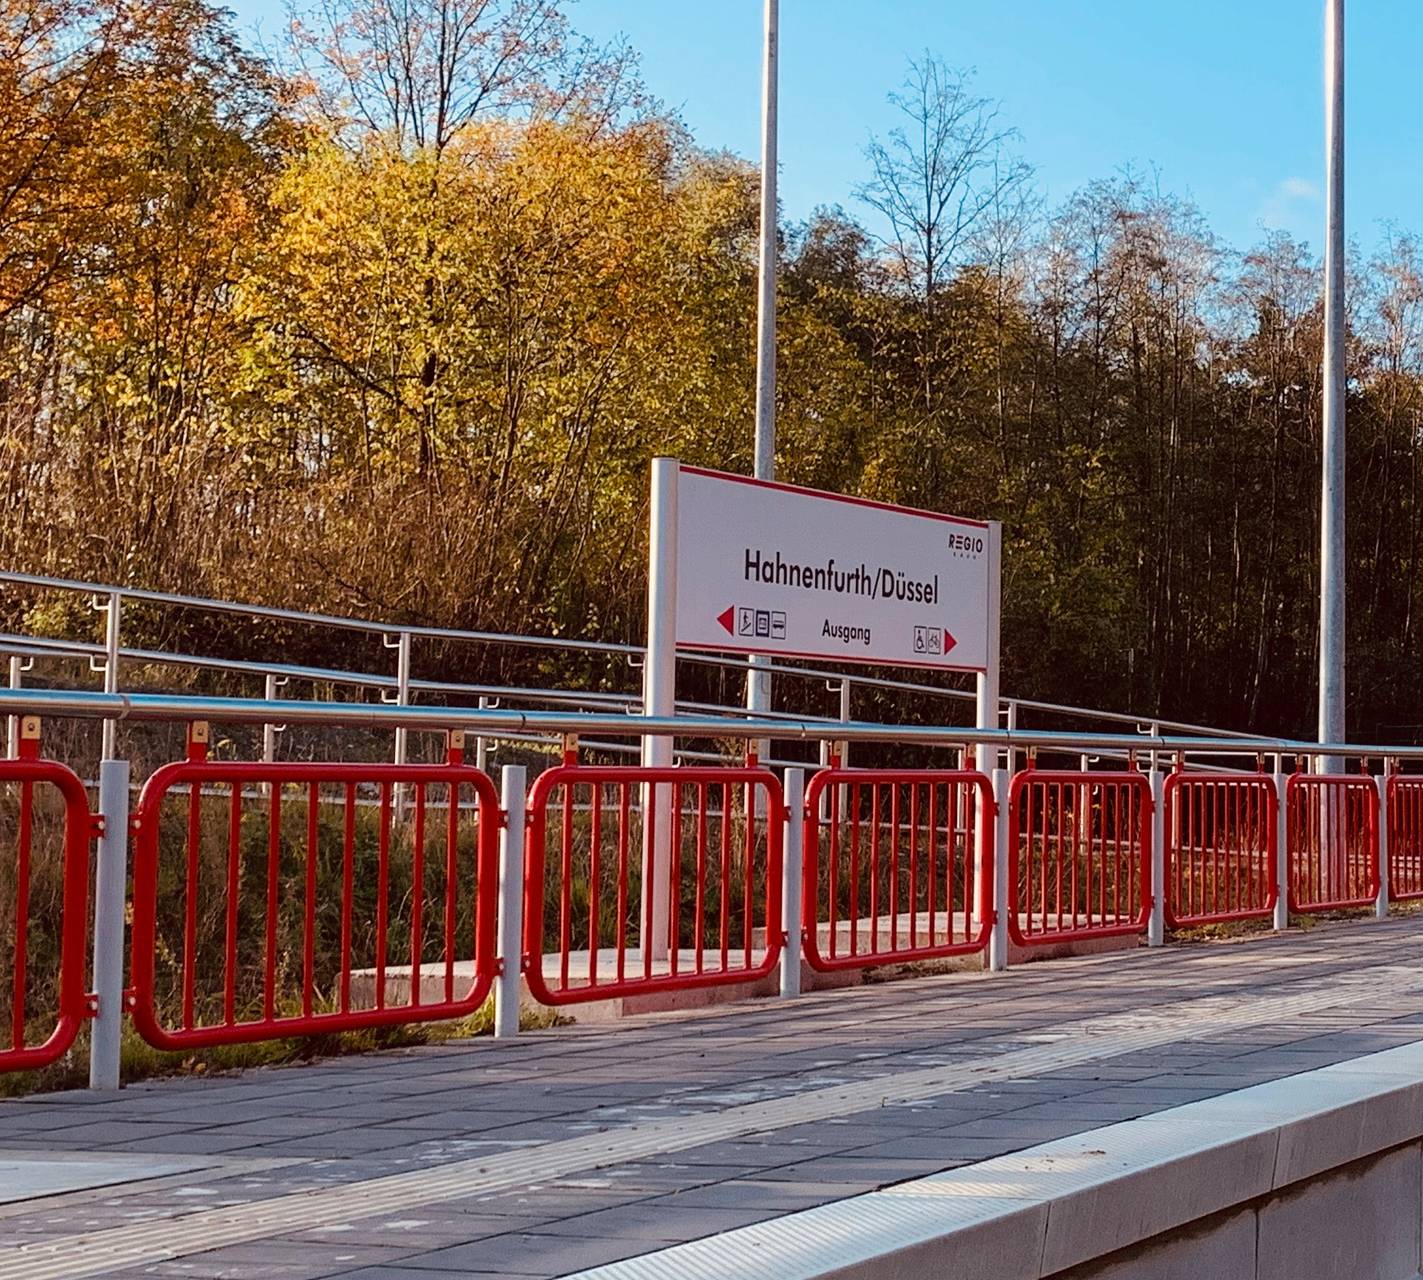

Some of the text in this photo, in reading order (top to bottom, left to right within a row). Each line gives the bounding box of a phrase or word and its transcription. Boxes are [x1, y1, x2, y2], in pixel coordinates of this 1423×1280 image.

[949, 534, 983, 553] REGIO
[744, 549, 938, 604] Hahnenfurth/Düssel
[822, 620, 871, 645] Ausgang
